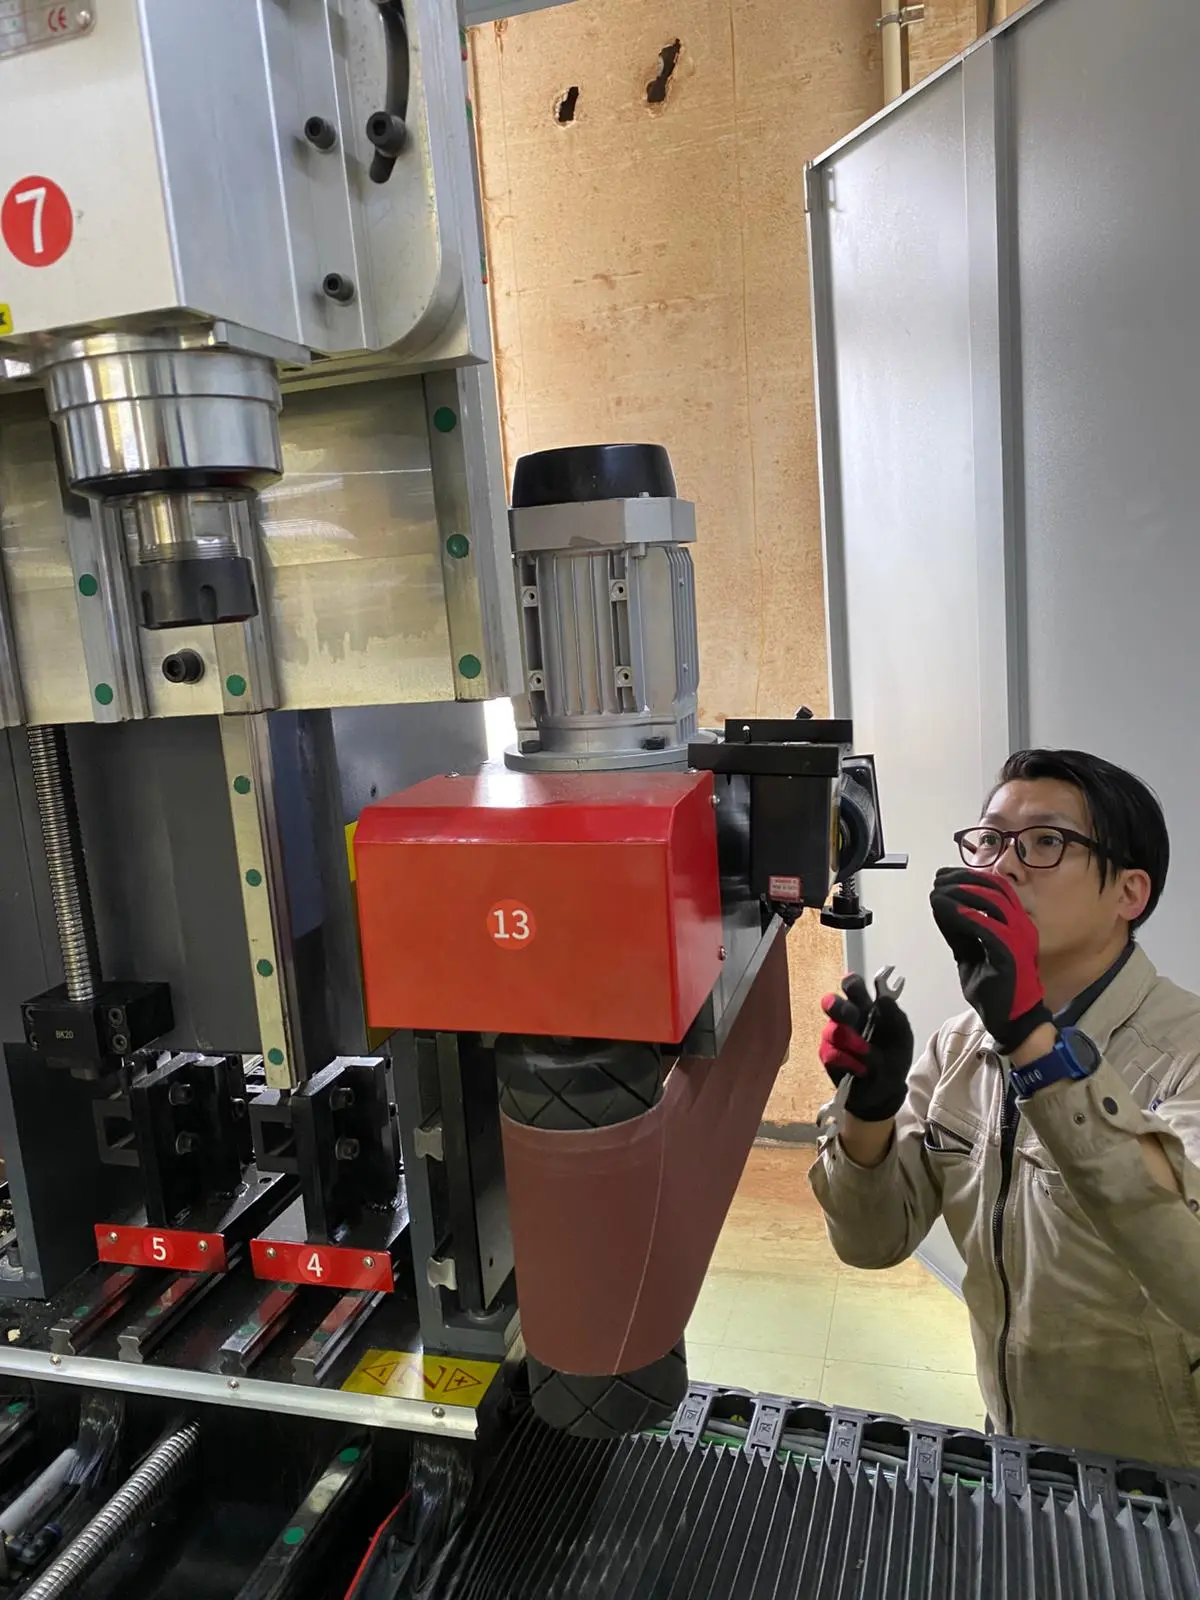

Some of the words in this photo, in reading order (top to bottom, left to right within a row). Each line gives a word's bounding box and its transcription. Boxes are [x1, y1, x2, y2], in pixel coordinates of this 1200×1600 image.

[15, 186, 47, 254] 7
[493, 909, 530, 940] 13
[152, 1236, 167, 1261] 5
[307, 1253, 323, 1277] 4
